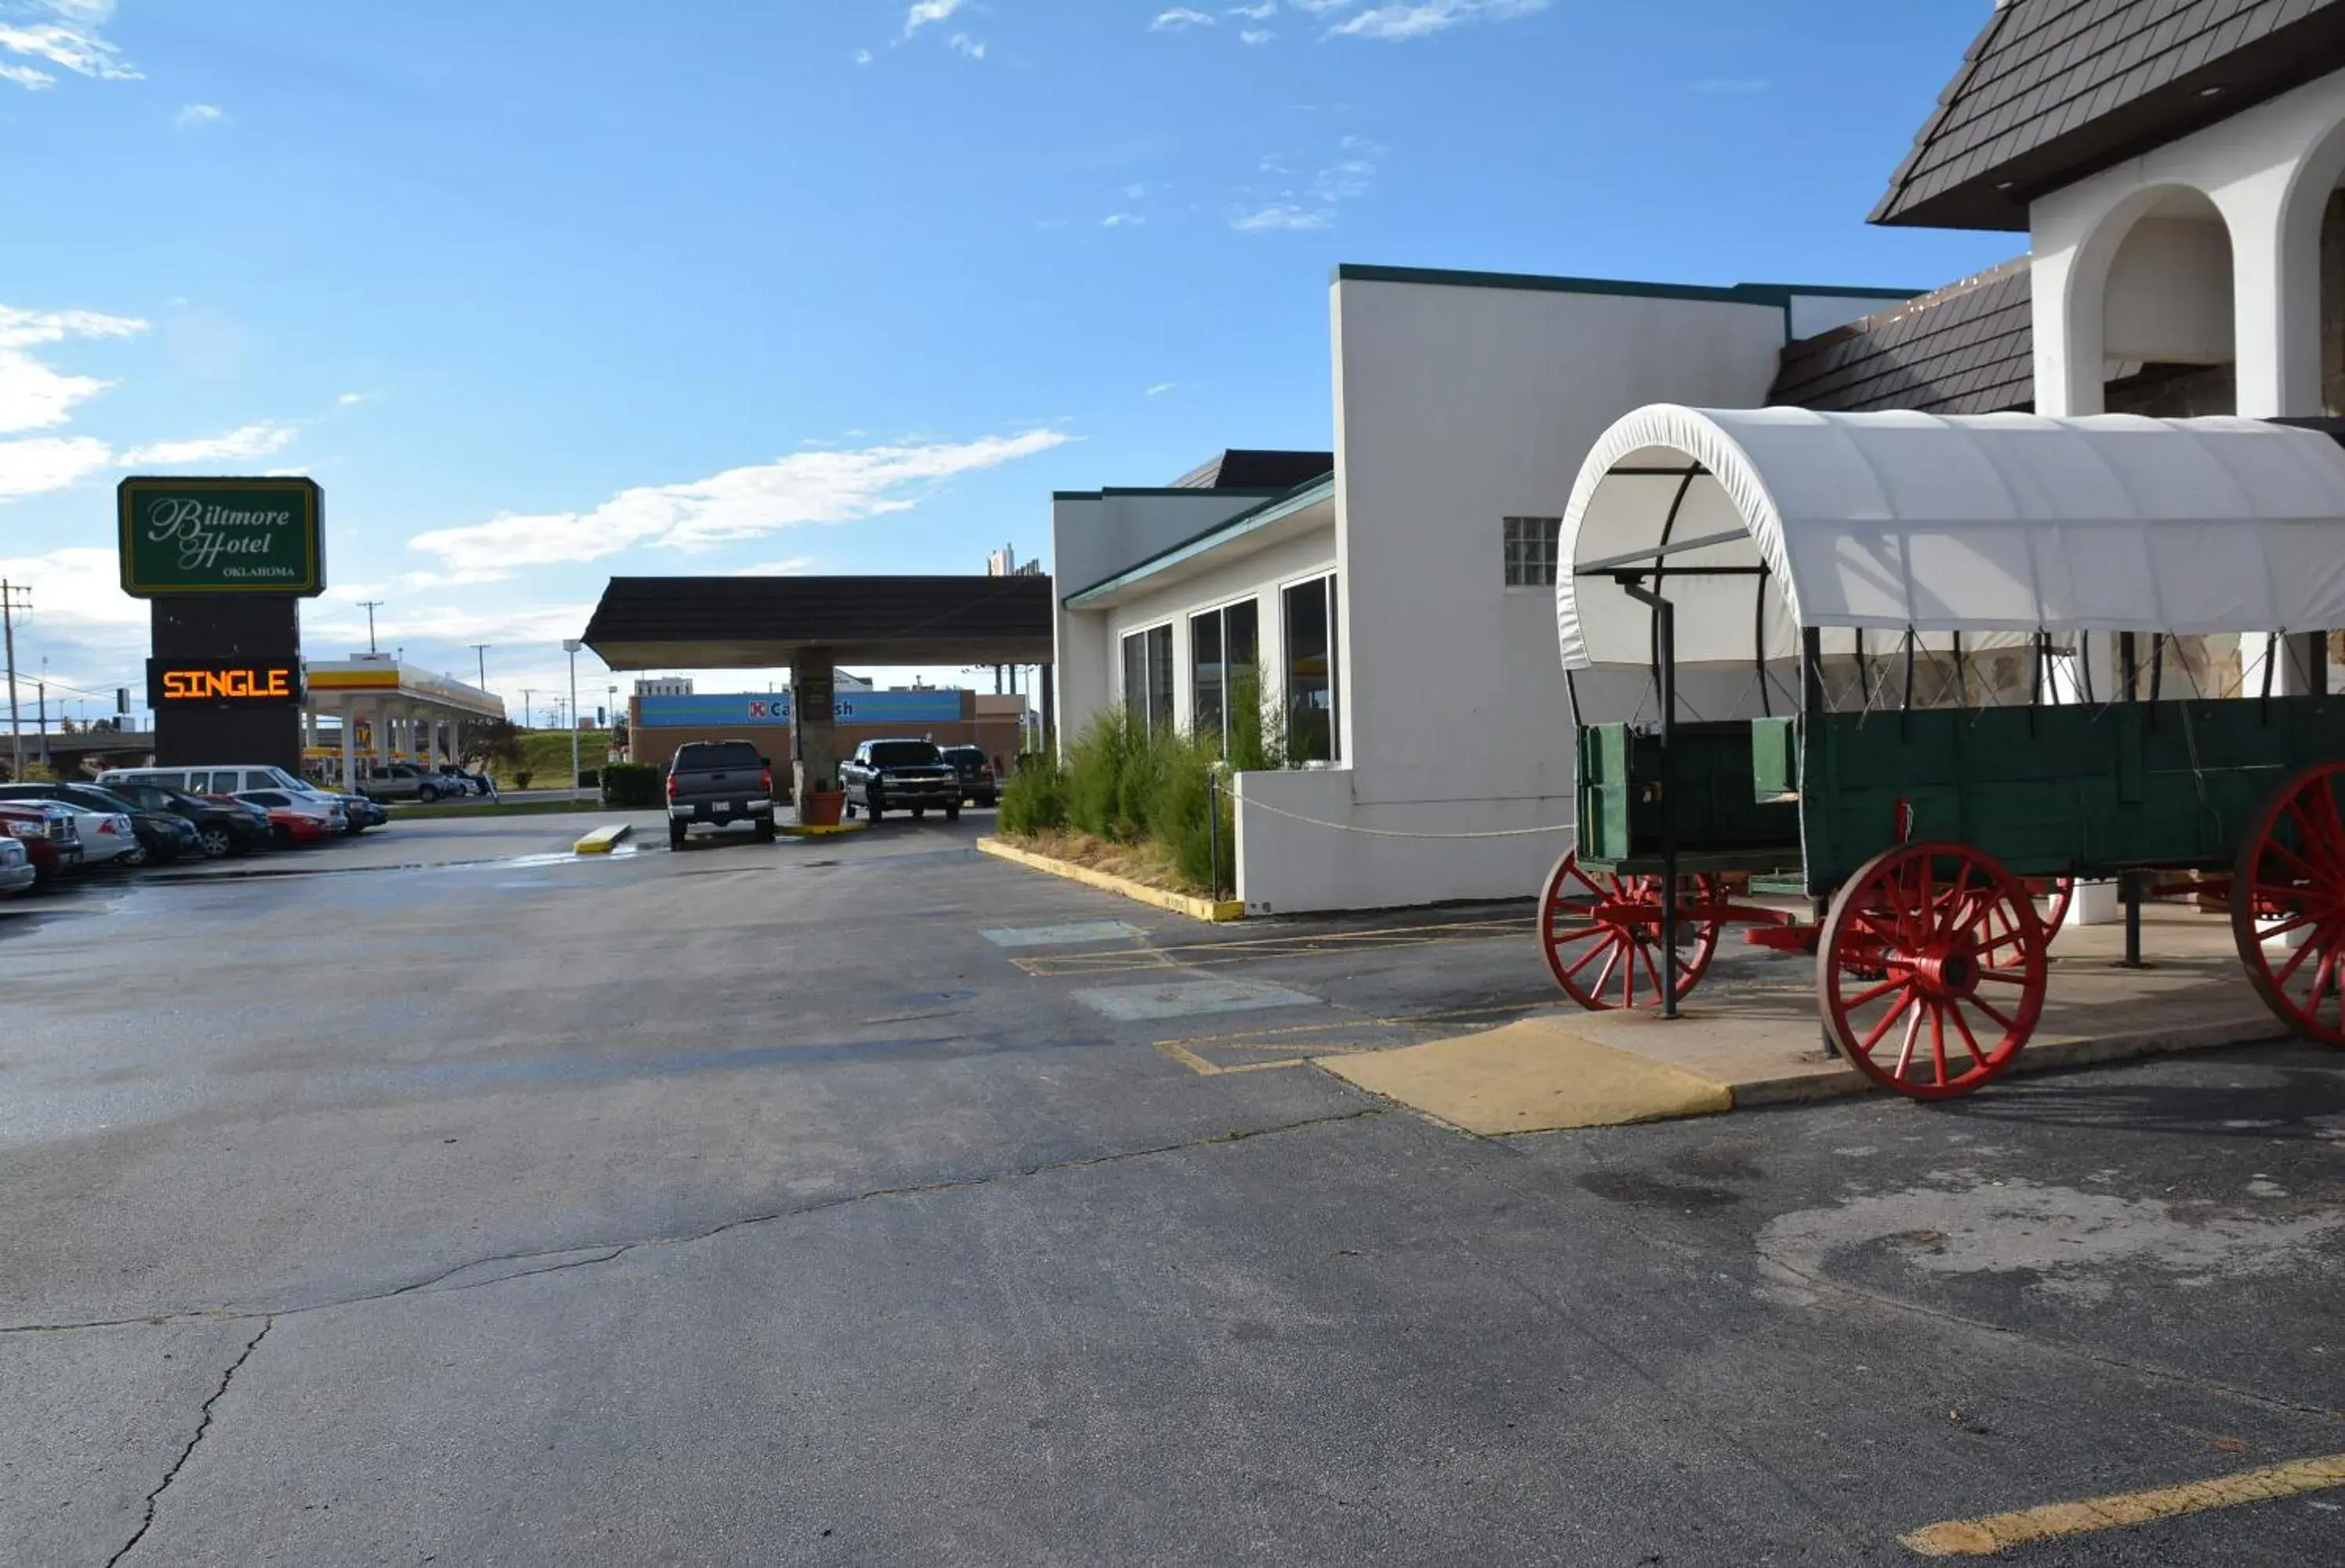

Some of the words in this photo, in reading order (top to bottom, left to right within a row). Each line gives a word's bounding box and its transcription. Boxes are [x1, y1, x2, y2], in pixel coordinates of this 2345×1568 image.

[147, 497, 290, 541] Biltmore
[178, 532, 272, 570] Hotel
[223, 566, 295, 577] OKLAHOMA
[163, 670, 289, 698] SINGLE
